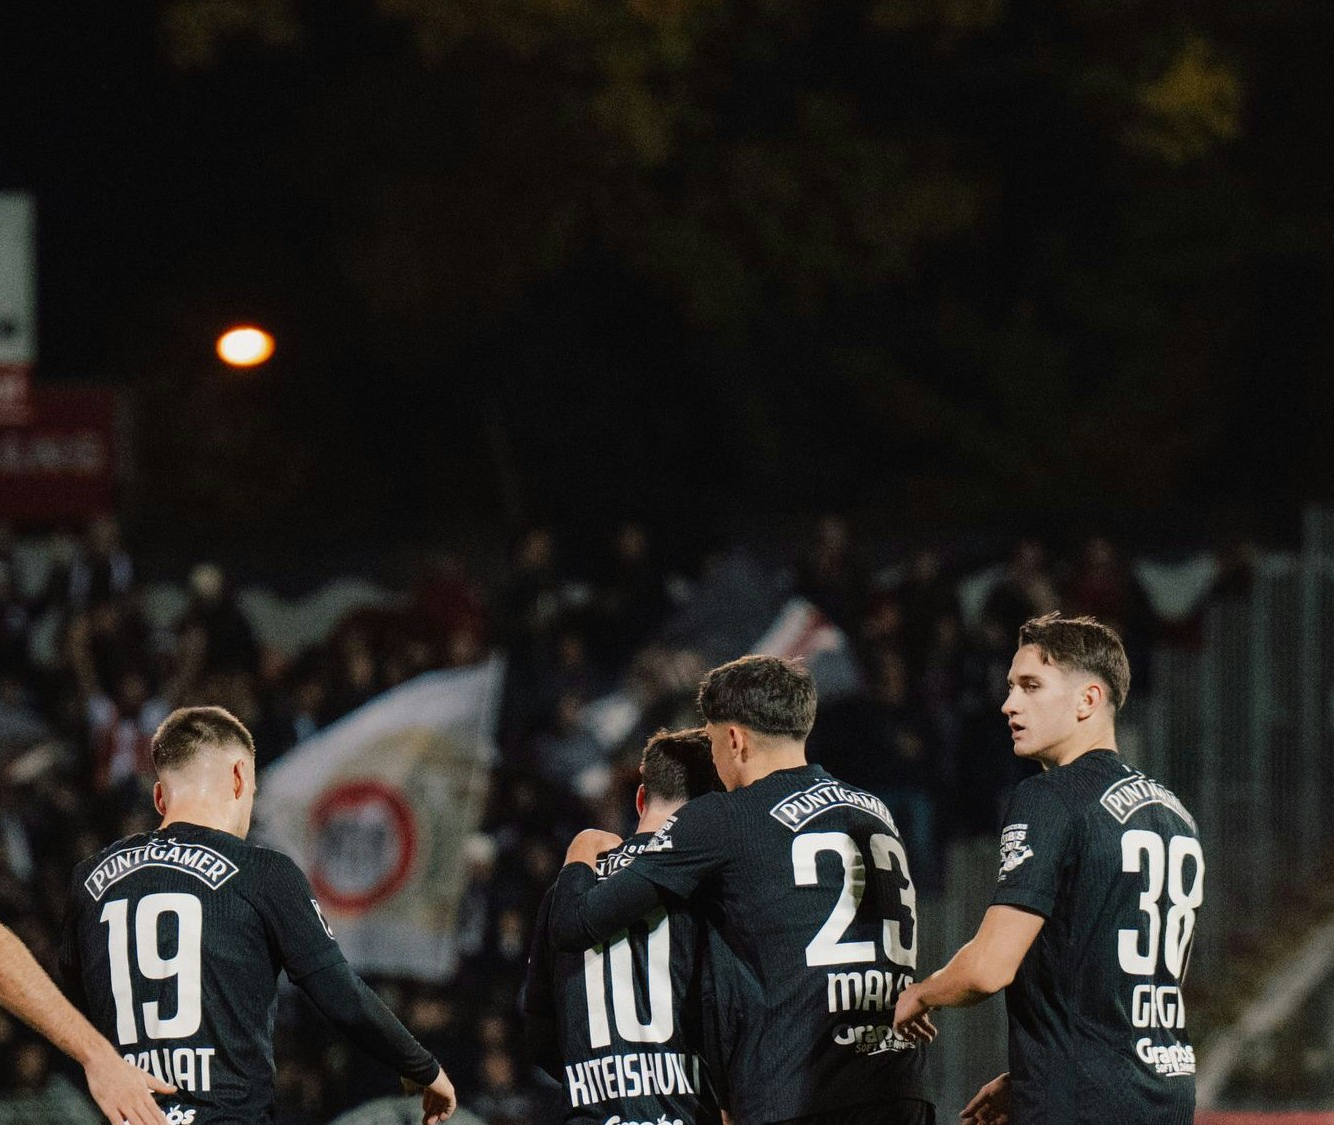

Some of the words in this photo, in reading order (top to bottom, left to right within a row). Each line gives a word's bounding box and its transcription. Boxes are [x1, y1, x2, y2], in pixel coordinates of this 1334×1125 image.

[92, 845, 227, 892] PUNTIGAMER
[792, 832, 918, 969] 23
[1118, 830, 1205, 978] 38
[99, 893, 203, 1045] 19
[584, 905, 674, 1049] 10
